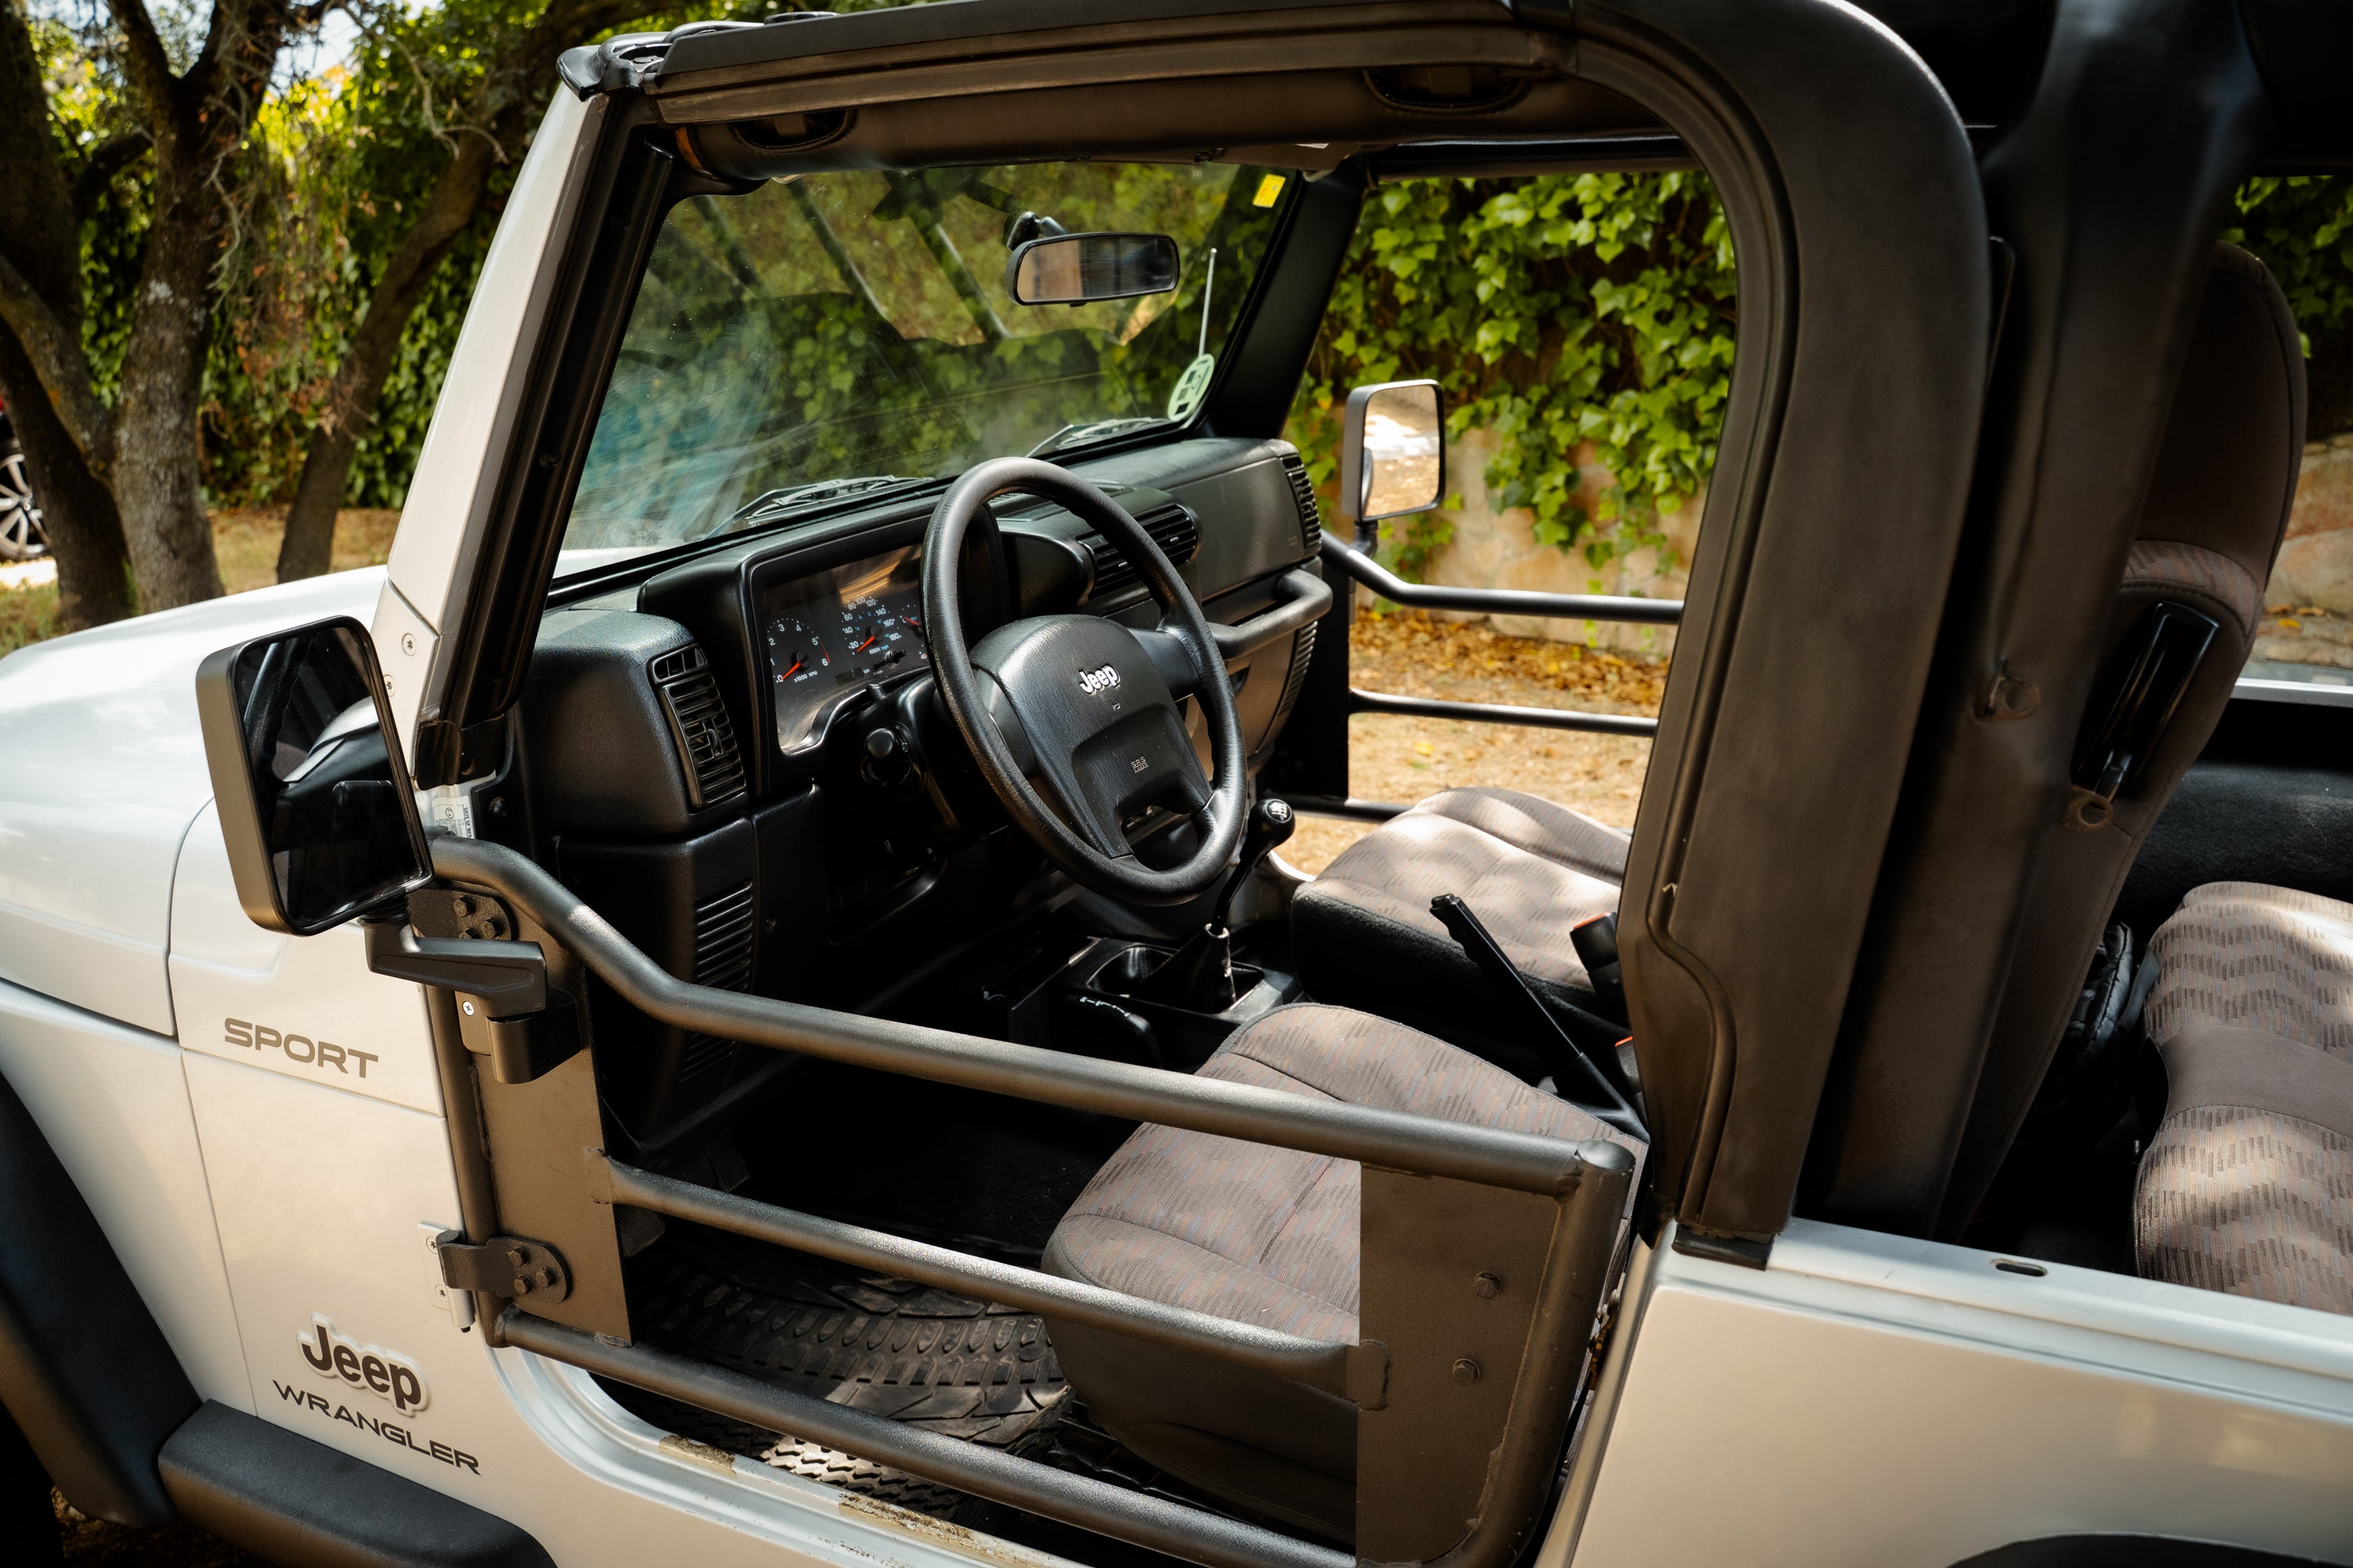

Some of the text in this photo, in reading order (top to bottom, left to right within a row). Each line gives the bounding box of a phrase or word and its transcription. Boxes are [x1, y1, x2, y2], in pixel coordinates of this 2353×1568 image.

[865, 599, 877, 607] 120
[875, 608, 886, 616] 140
[844, 613, 852, 621] 60
[883, 618, 894, 627] 160
[778, 624, 785, 632] 3
[811, 637, 818, 645] 5
[889, 632, 900, 641] 180
[768, 638, 776, 646] 2
[850, 641, 859, 649] 20
[822, 658, 828, 666] 6
[777, 674, 784, 683] 0
[793, 673, 808, 683] x1000
[1078, 665, 1120, 694] Jeep
[1131, 756, 1146, 768] SRS
[224, 1017, 379, 1079] SPORT
[301, 1323, 423, 1411] Jeep
[272, 1378, 482, 1477] WRANGLER
